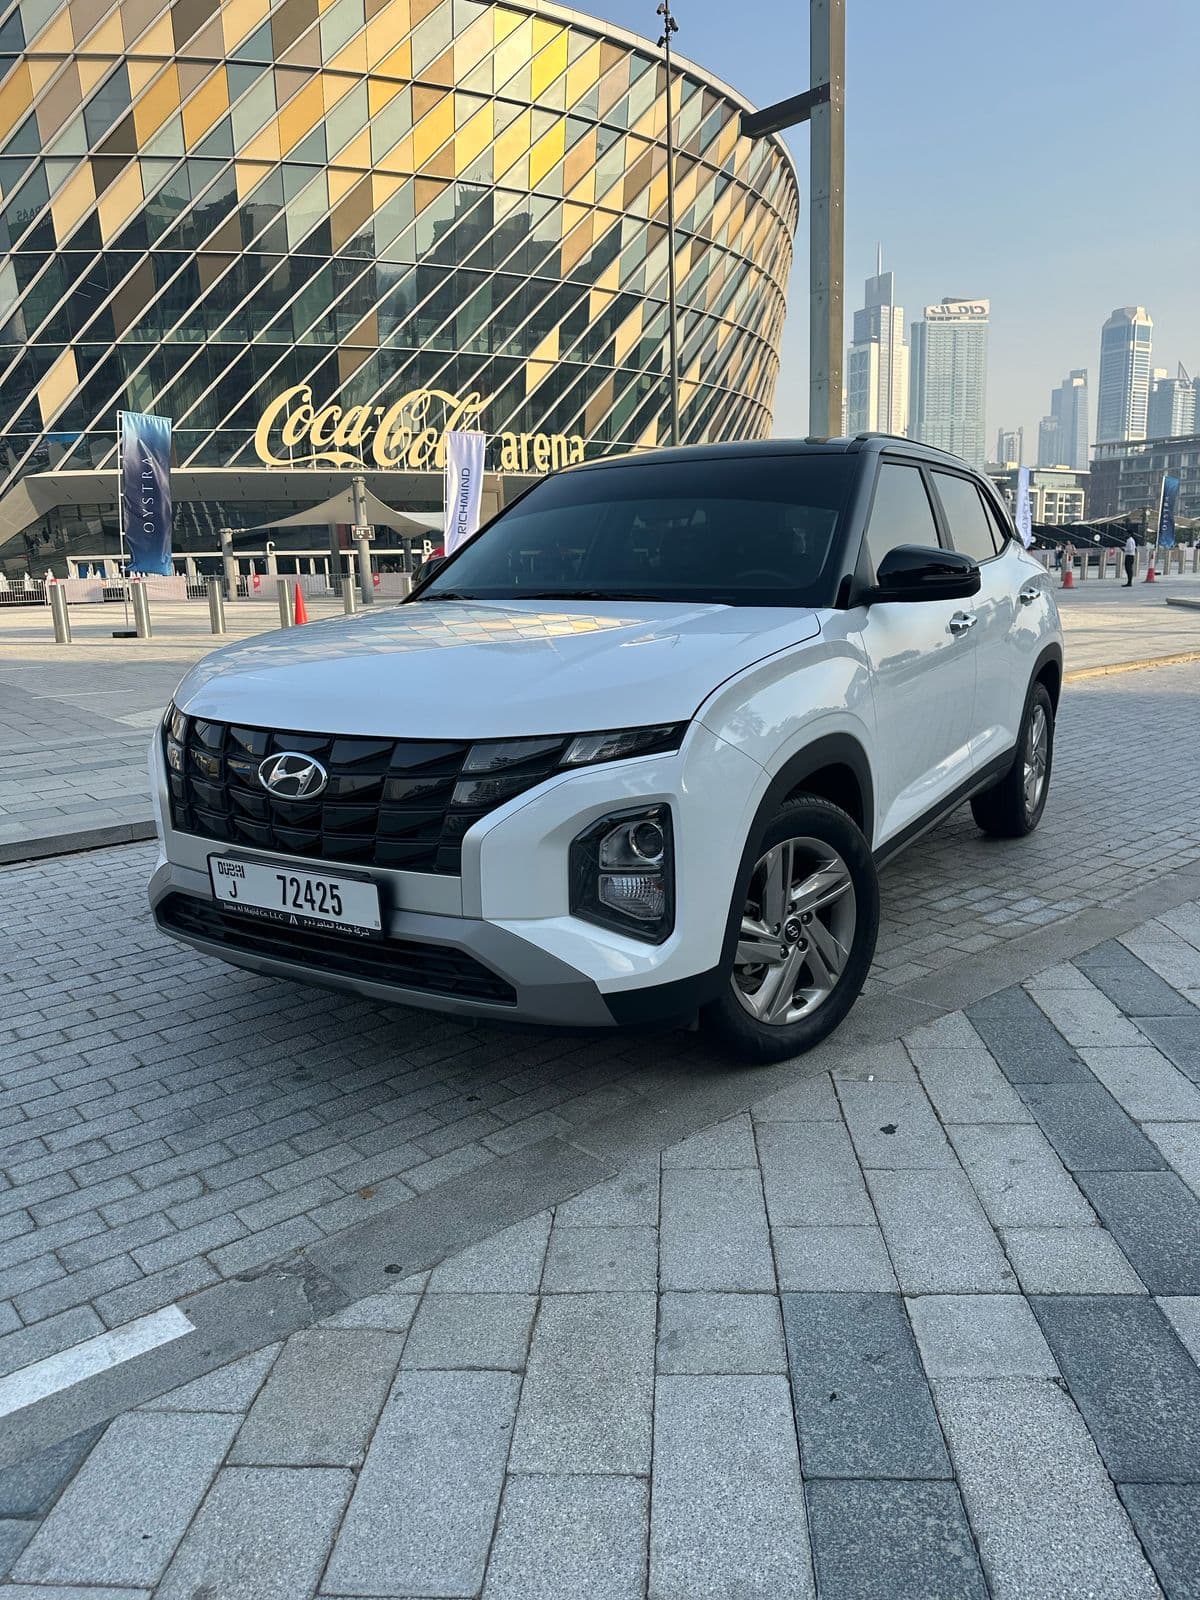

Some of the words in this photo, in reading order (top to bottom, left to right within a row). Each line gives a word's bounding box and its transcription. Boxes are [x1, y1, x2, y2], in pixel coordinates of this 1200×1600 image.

[254, 384, 492, 468] Coca-Col
[501, 431, 586, 471] arena
[141, 456, 155, 534] OYSTRA
[457, 467, 471, 535] RICHMIND
[423, 539, 433, 555] B
[276, 874, 343, 916] 72425
